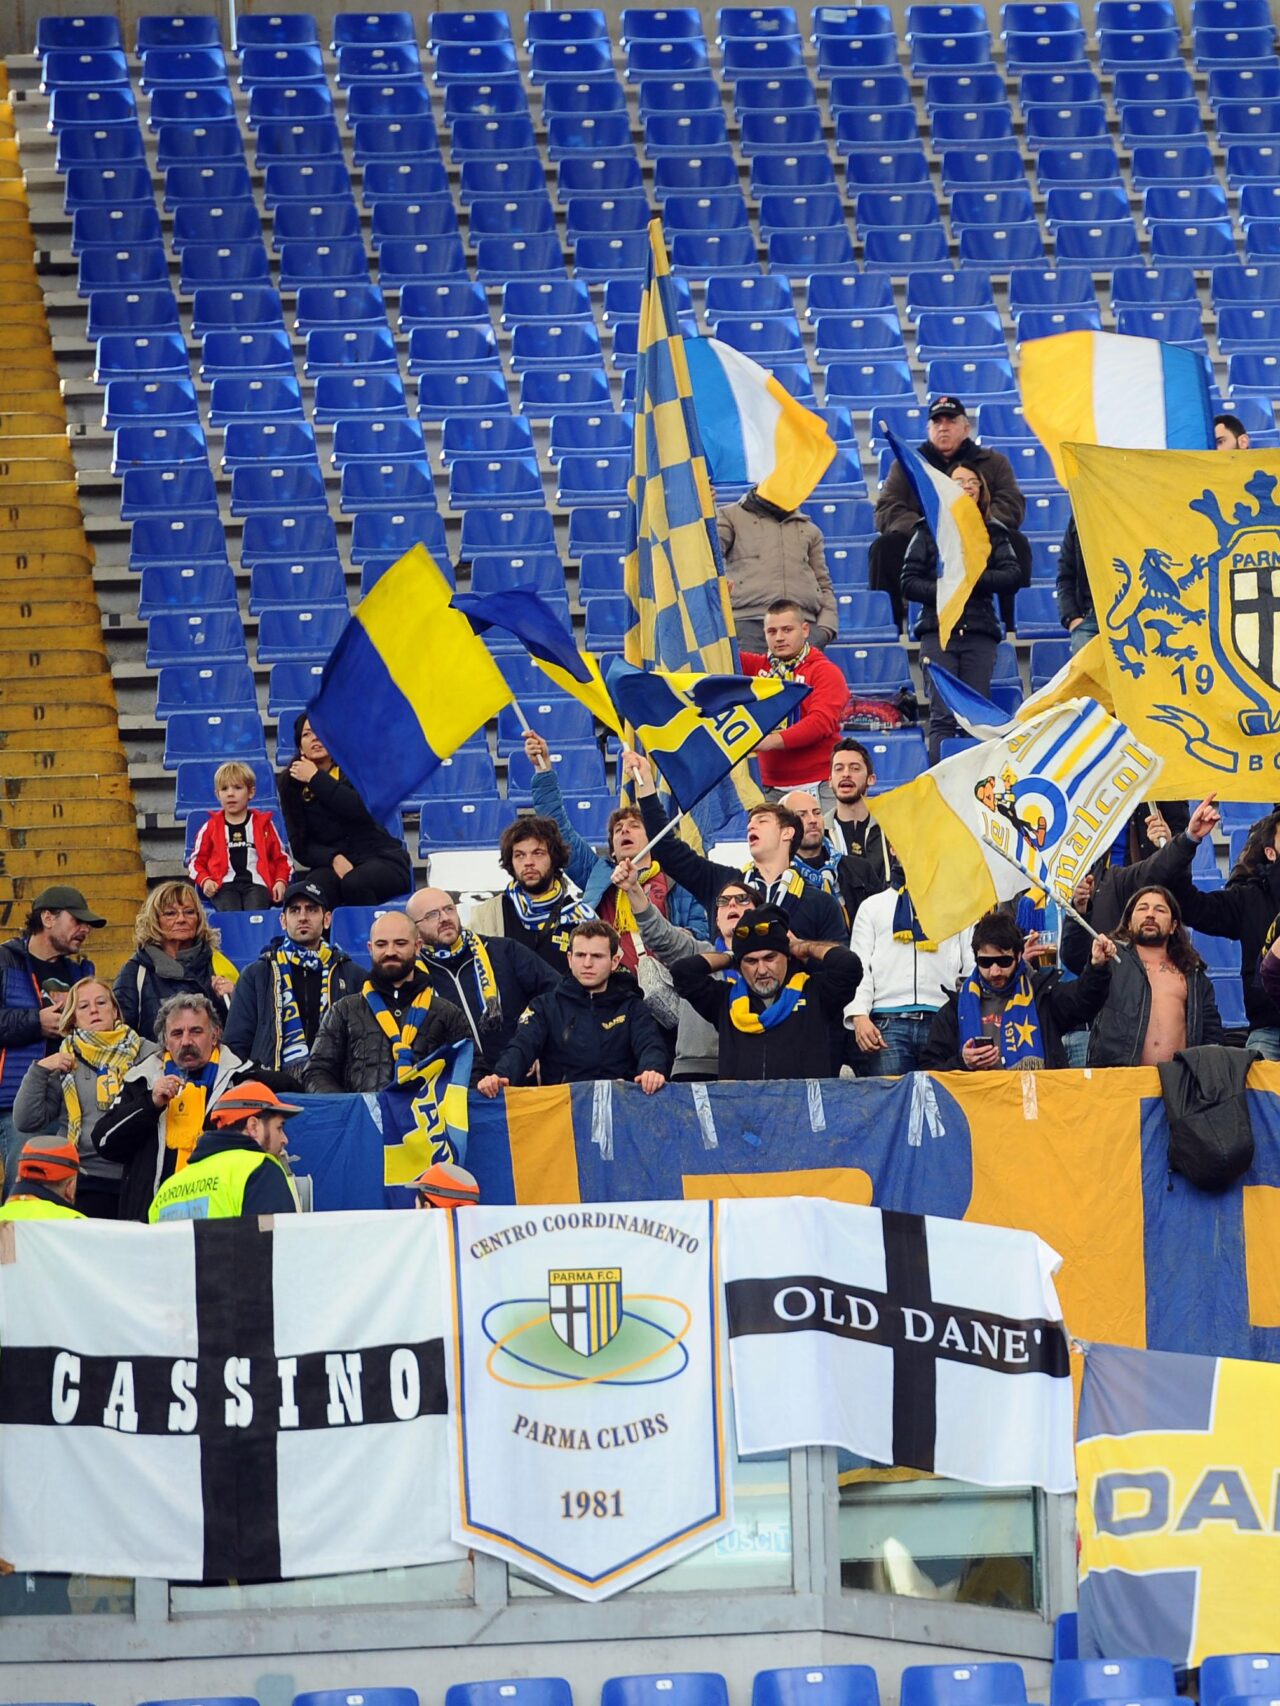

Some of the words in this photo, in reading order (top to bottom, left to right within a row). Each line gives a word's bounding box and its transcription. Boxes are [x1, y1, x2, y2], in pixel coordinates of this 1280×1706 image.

[1171, 663, 1215, 697] 19
[1004, 1021, 1018, 1052] 1977
[155, 1177, 219, 1208] COORDINATORE
[470, 1220, 538, 1260] CENTRO
[542, 1212, 699, 1254] COORDINAMENTO
[553, 1271, 594, 1281] PARMA
[597, 1270, 617, 1280] F.C.
[772, 1285, 880, 1332] OLD
[902, 1306, 1044, 1366] DANE'
[50, 1347, 423, 1433] CASSINO
[512, 1412, 593, 1450] PARMA
[596, 1411, 671, 1450] CLUBS
[560, 1489, 626, 1520] 1981
